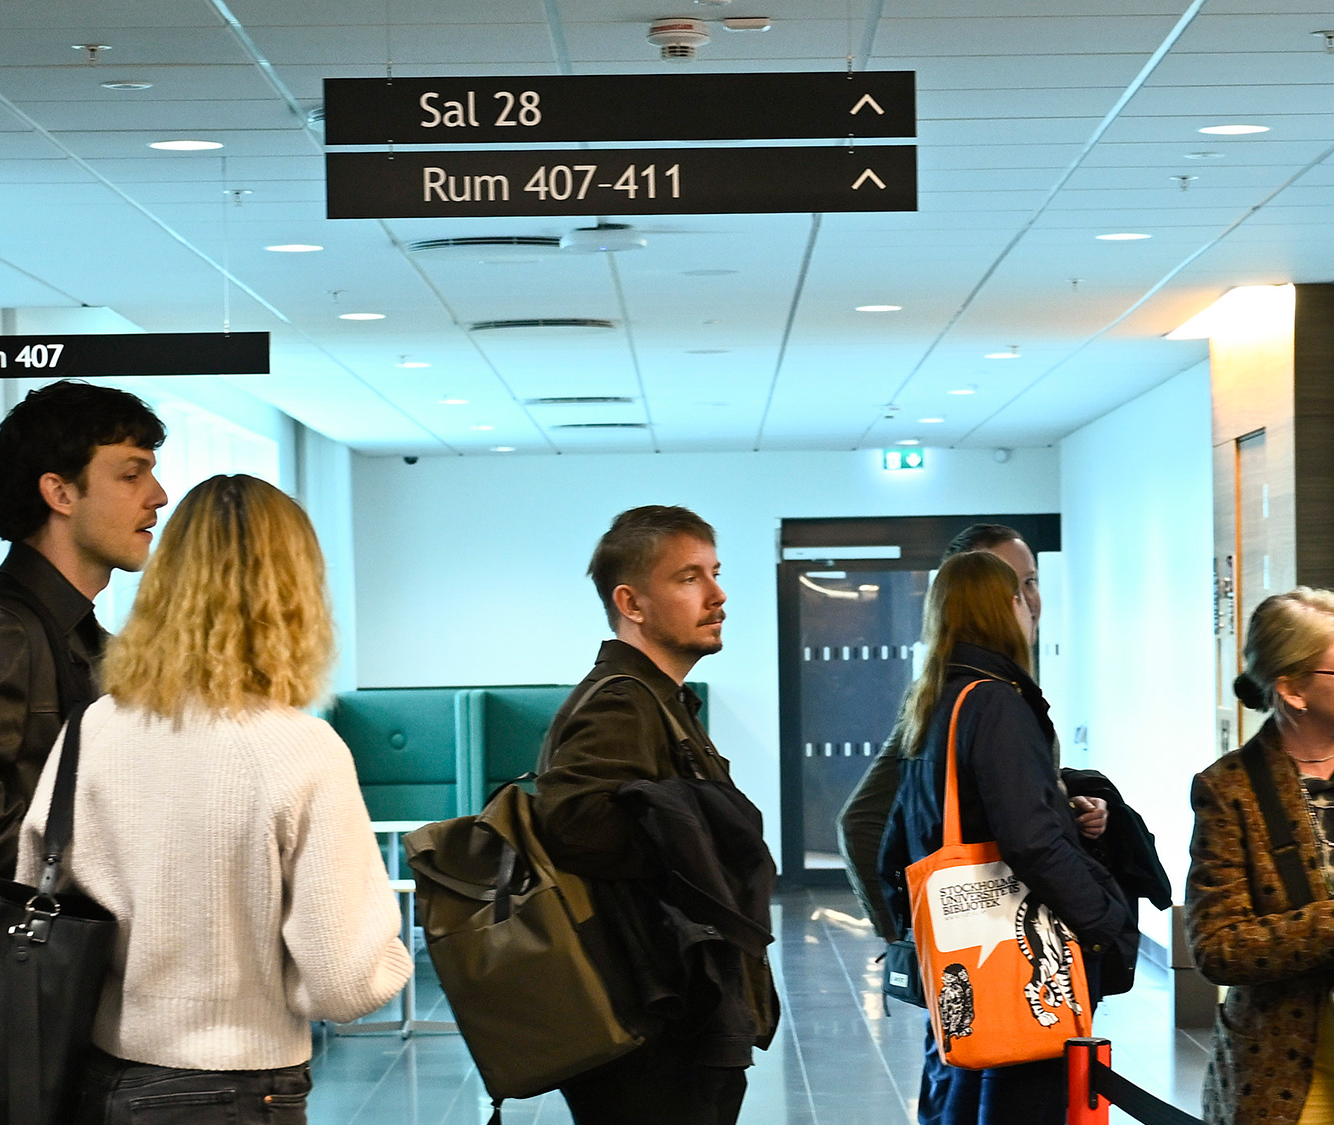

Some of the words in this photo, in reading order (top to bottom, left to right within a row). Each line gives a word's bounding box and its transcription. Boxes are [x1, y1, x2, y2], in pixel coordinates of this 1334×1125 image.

[419, 90, 480, 128] Sal
[493, 90, 543, 127] 28
[423, 167, 510, 202] Rum
[523, 164, 680, 200] 407-411
[14, 343, 65, 368] 407
[942, 898, 1001, 915] BIBLIOTEK
